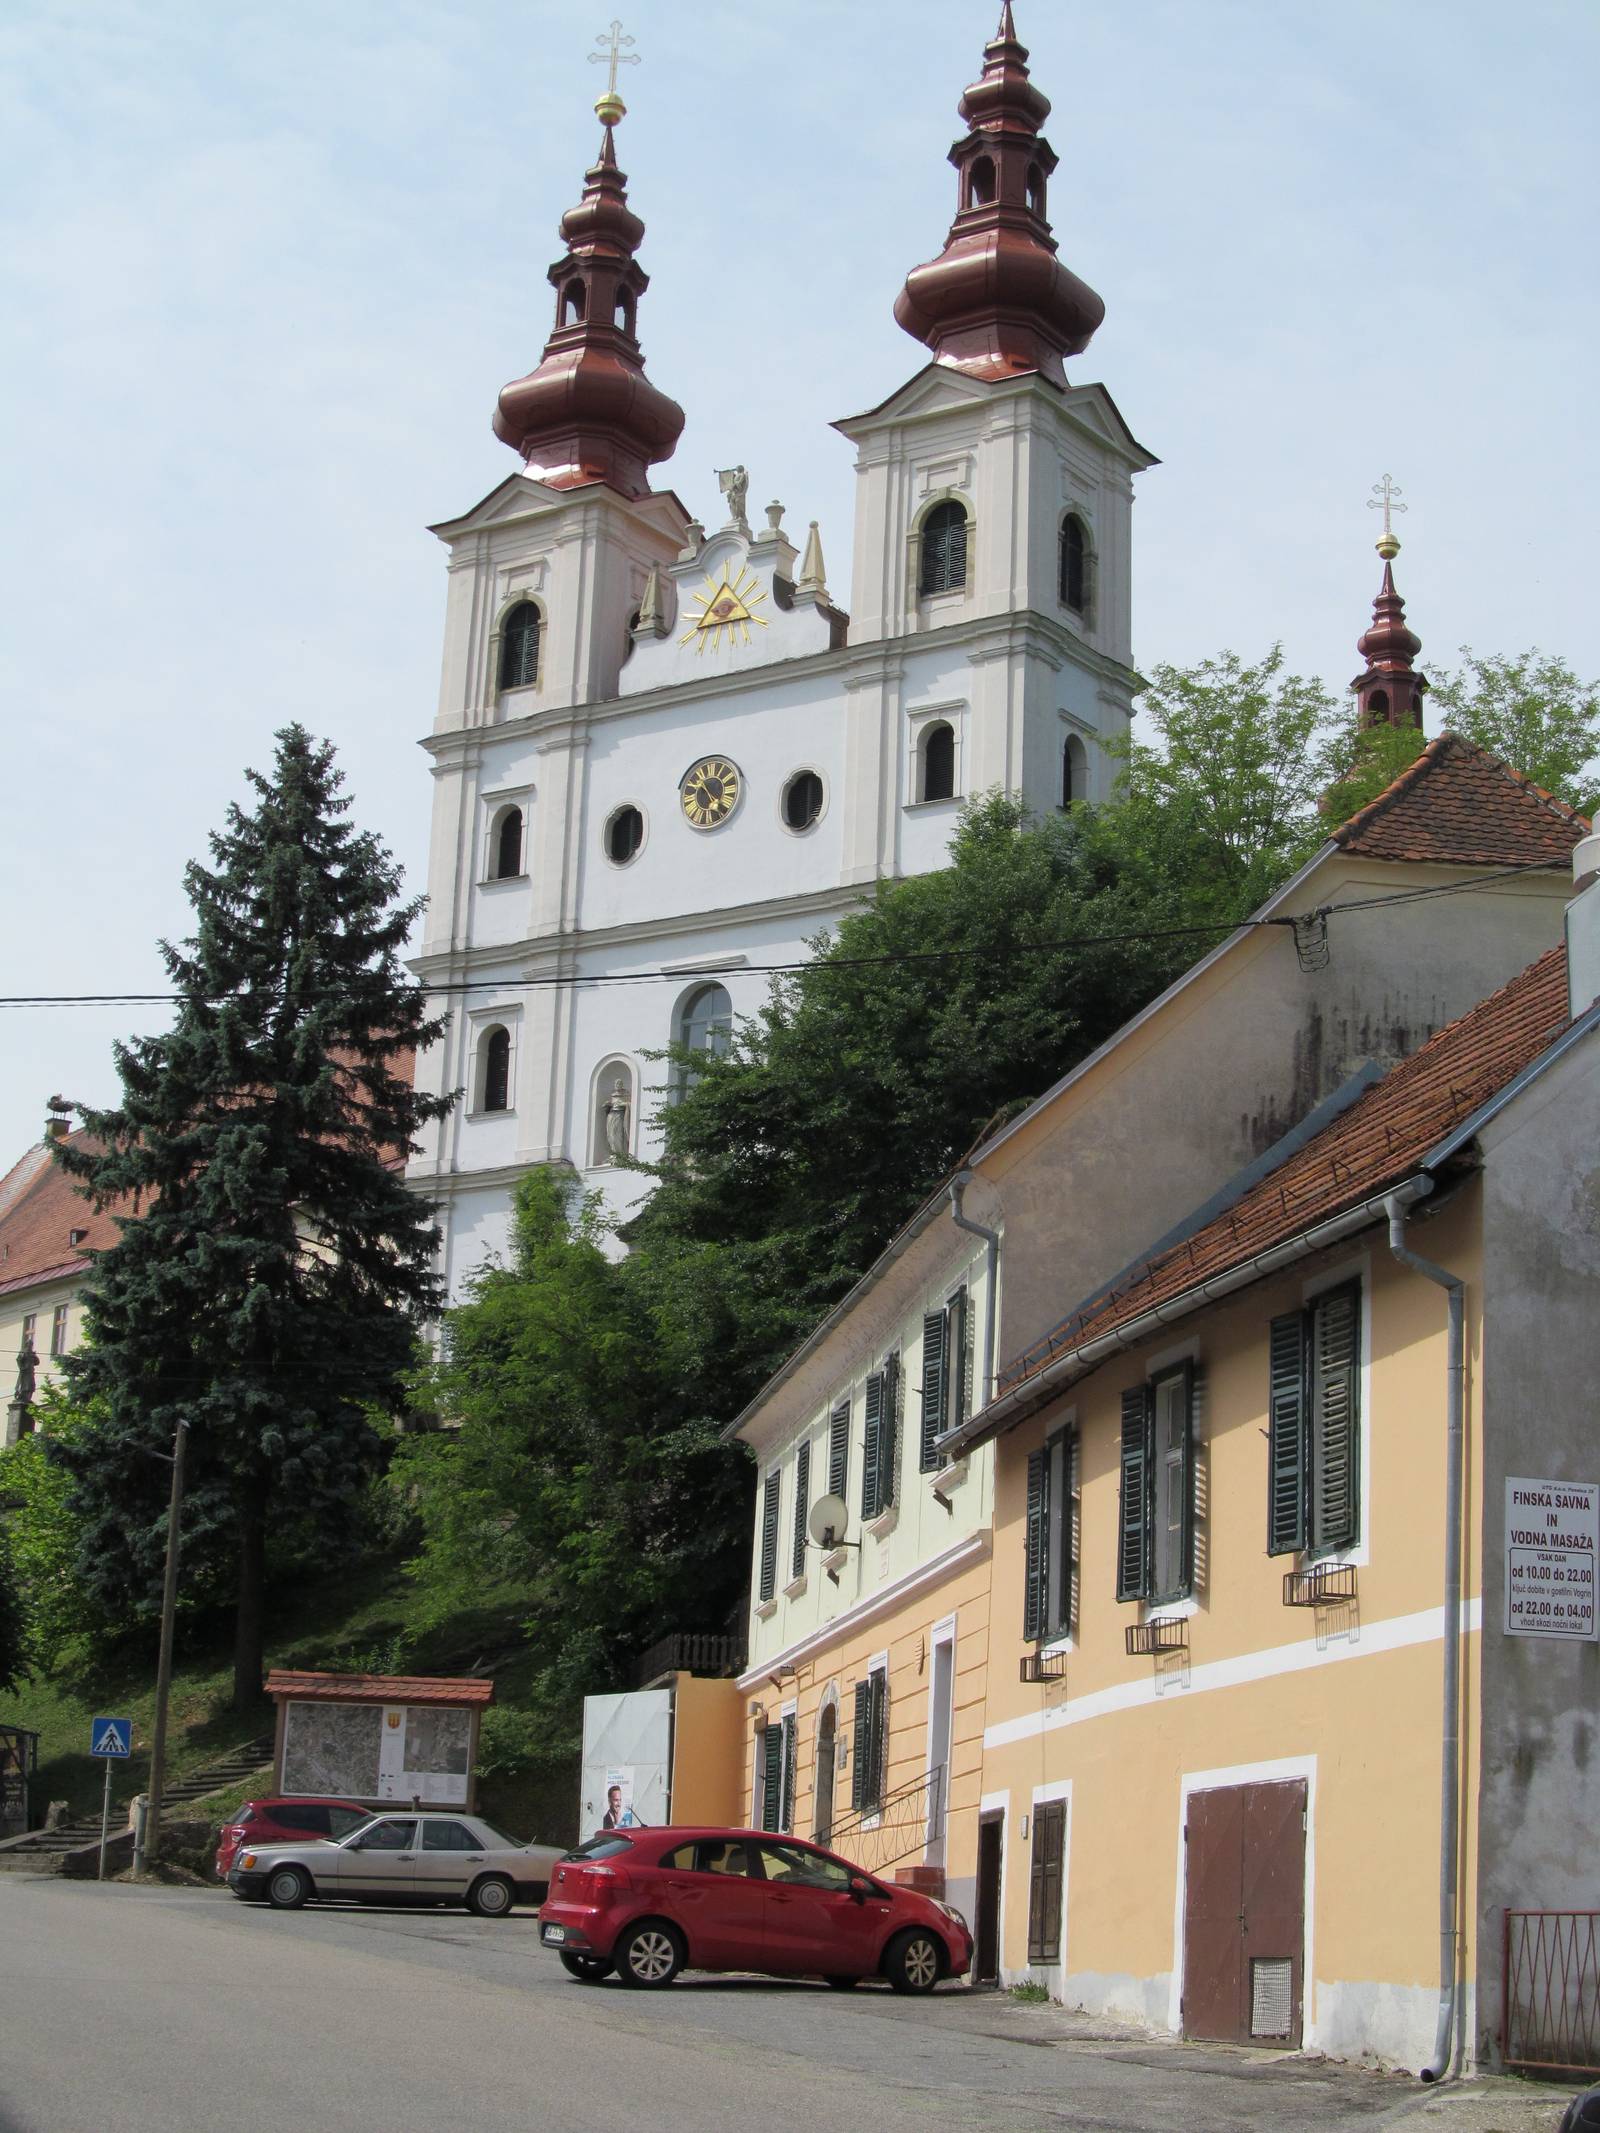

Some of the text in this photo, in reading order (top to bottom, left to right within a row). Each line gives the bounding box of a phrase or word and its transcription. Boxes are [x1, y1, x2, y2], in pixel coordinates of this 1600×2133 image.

[1513, 1491, 1590, 1510] FINSKA SAVNA
[1546, 1514, 1558, 1527] IN
[1510, 1530, 1547, 1546] VODNA
[1536, 1553, 1567, 1563] VSAK DAN
[1512, 1565, 1592, 1583] od 10.00 do 22.00
[1527, 1584, 1545, 1596] dobite
[1573, 1588, 1592, 1600] Vogrin
[1511, 1600, 1592, 1619] od 22.00 do 04.00
[1520, 1617, 1535, 1627] vhod
